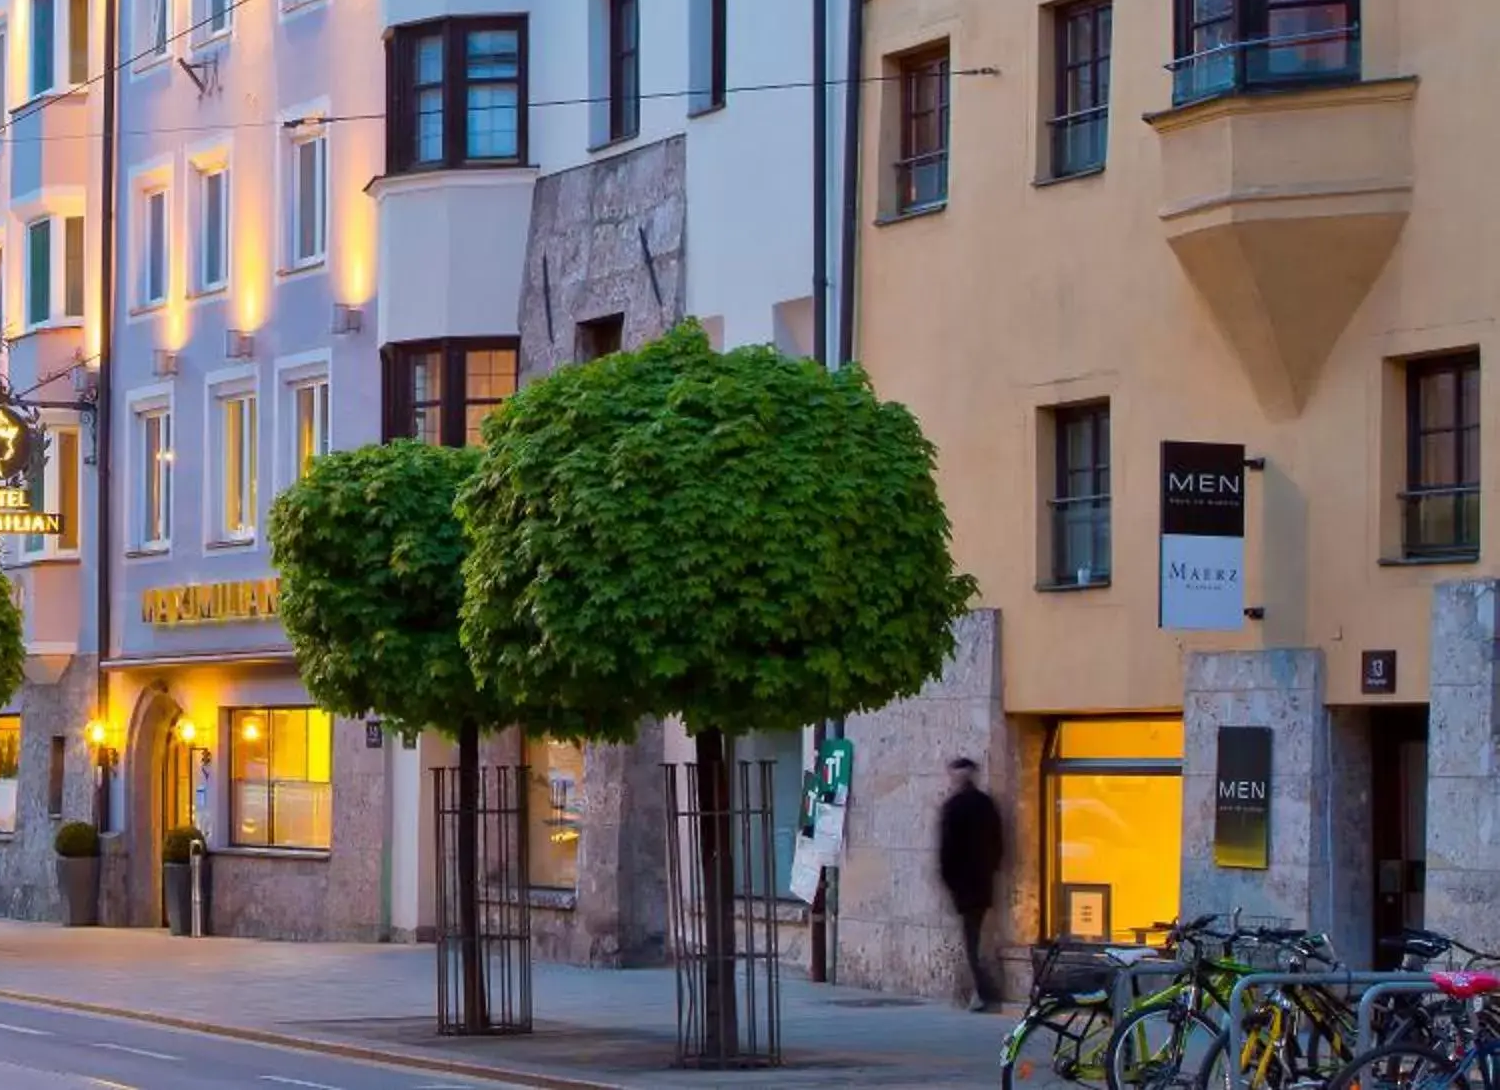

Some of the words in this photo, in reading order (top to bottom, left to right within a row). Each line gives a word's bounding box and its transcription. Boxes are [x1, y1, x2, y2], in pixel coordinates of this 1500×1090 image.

[1169, 472, 1239, 494] MEN
[1168, 562, 1237, 581] MAERZ
[1219, 781, 1266, 799] MEN
